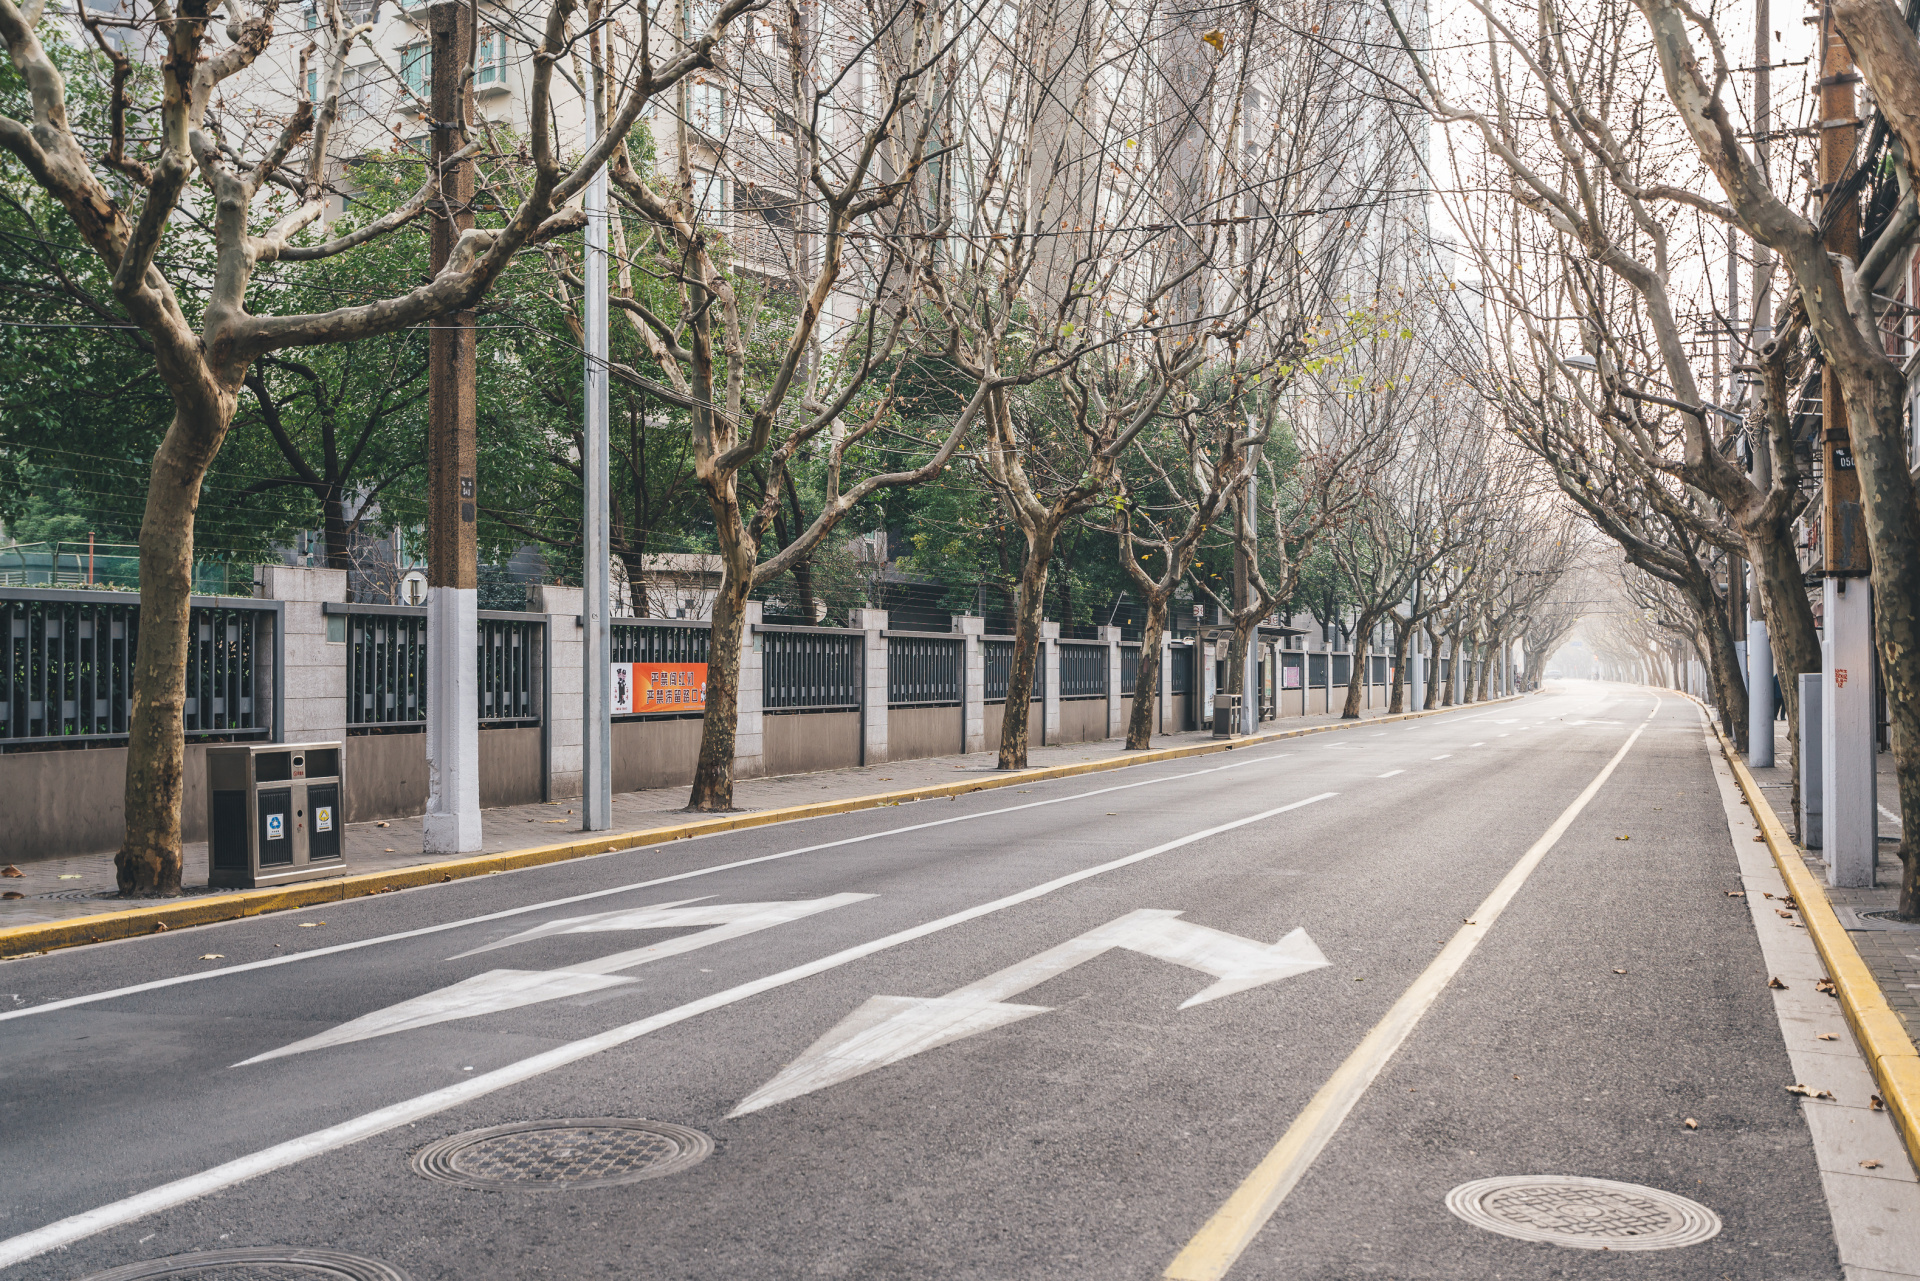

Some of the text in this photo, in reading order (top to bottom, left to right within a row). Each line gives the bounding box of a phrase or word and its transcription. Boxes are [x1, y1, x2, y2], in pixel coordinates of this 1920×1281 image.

[651, 672, 694, 687] 严禁闯红灯
[646, 689, 698, 704] 严禁滞留路口
